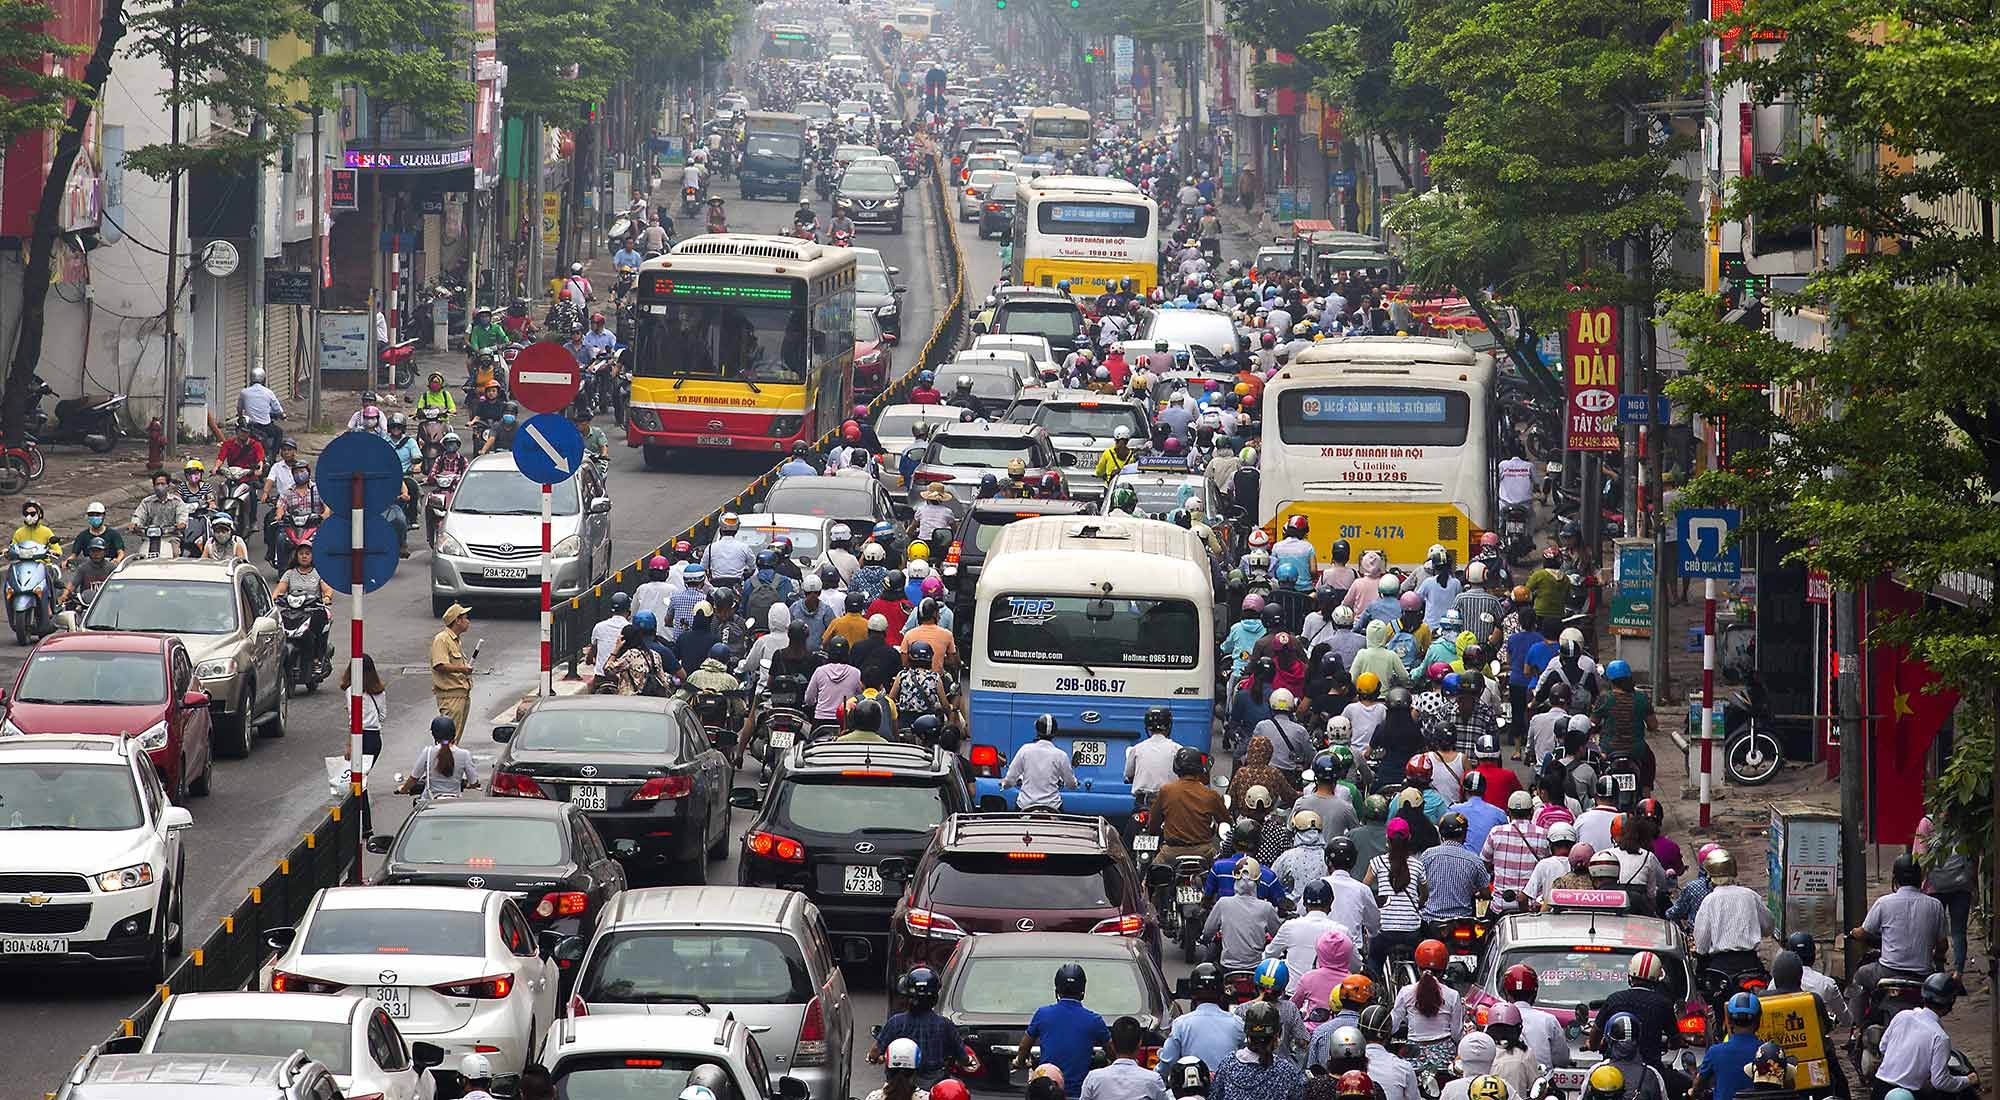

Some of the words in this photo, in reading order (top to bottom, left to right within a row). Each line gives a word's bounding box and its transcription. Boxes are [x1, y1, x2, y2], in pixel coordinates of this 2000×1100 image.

[1578, 306, 1611, 344] ÁO
[1574, 346, 1616, 386] DÀI
[1304, 400, 1320, 413] 02
[1581, 394, 1611, 408] 117
[1573, 412, 1593, 433] TÂY
[1336, 447, 1353, 458] BUS
[1355, 448, 1388, 458] NHANH
[1405, 447, 1423, 460] NỘI
[1363, 462, 1397, 470] Hotline
[1341, 471, 1372, 481] 1900
[1378, 472, 1408, 482] 1296
[1340, 524, 1362, 538] 30T
[1374, 525, 1405, 539] 4174
[484, 568, 526, 578] 29A-522.47
[1701, 562, 1722, 573] QUAY
[1723, 562, 1735, 573] XE
[1008, 599, 1057, 617] TPP
[993, 649, 1063, 661] www.thuexetpp.com
[1055, 678, 1126, 693] 29B-086.97
[1080, 742, 1099, 753] 29B
[579, 786, 599, 798] 30A
[854, 866, 874, 879] 29A
[845, 879, 882, 892] 473.38
[1573, 892, 1604, 902] TAXI
[5, 940, 67, 953] 30A-484.71
[377, 988, 400, 1002] 30A
